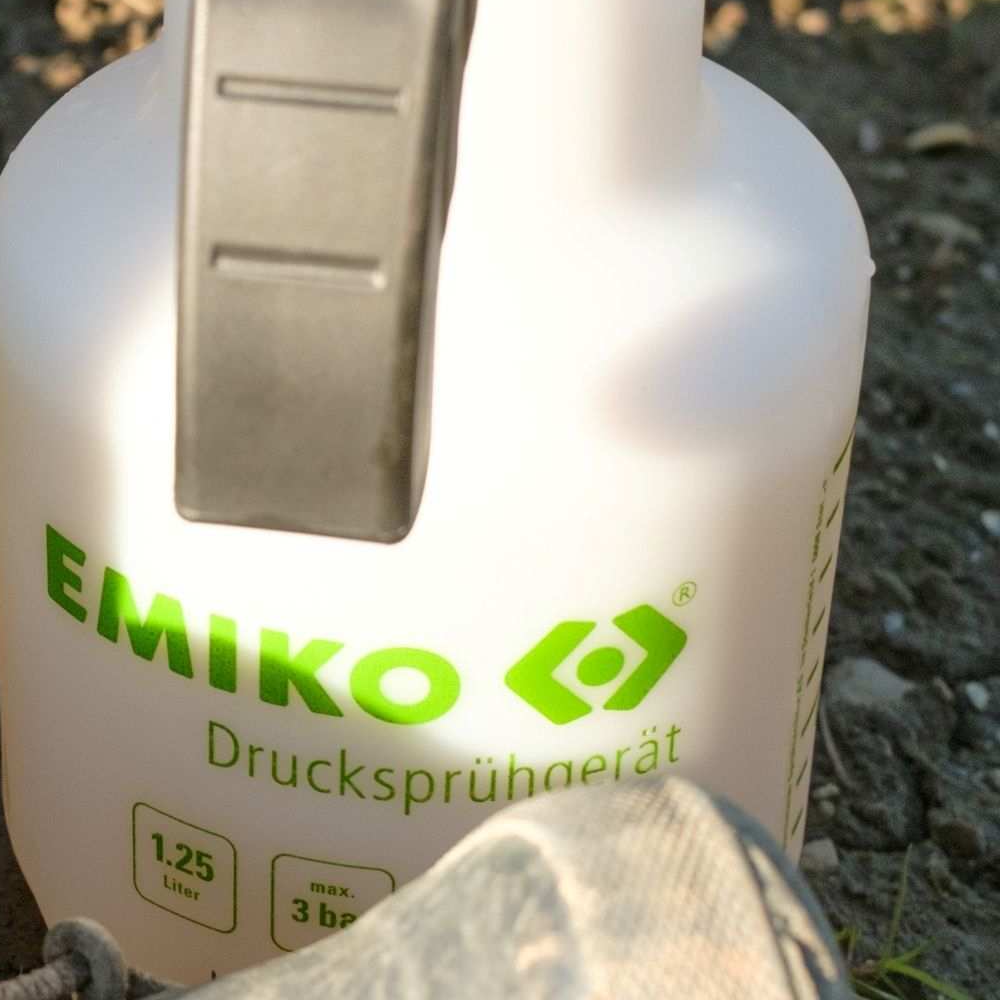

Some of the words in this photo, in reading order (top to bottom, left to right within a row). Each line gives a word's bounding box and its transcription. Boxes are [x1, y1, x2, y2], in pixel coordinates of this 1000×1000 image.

[44, 523, 462, 727] EMIKO
[151, 832, 215, 883] 1.25
[163, 874, 201, 902] Liter
[310, 880, 356, 899] max.
[291, 898, 310, 924] 3
[319, 901, 360, 930] ba
